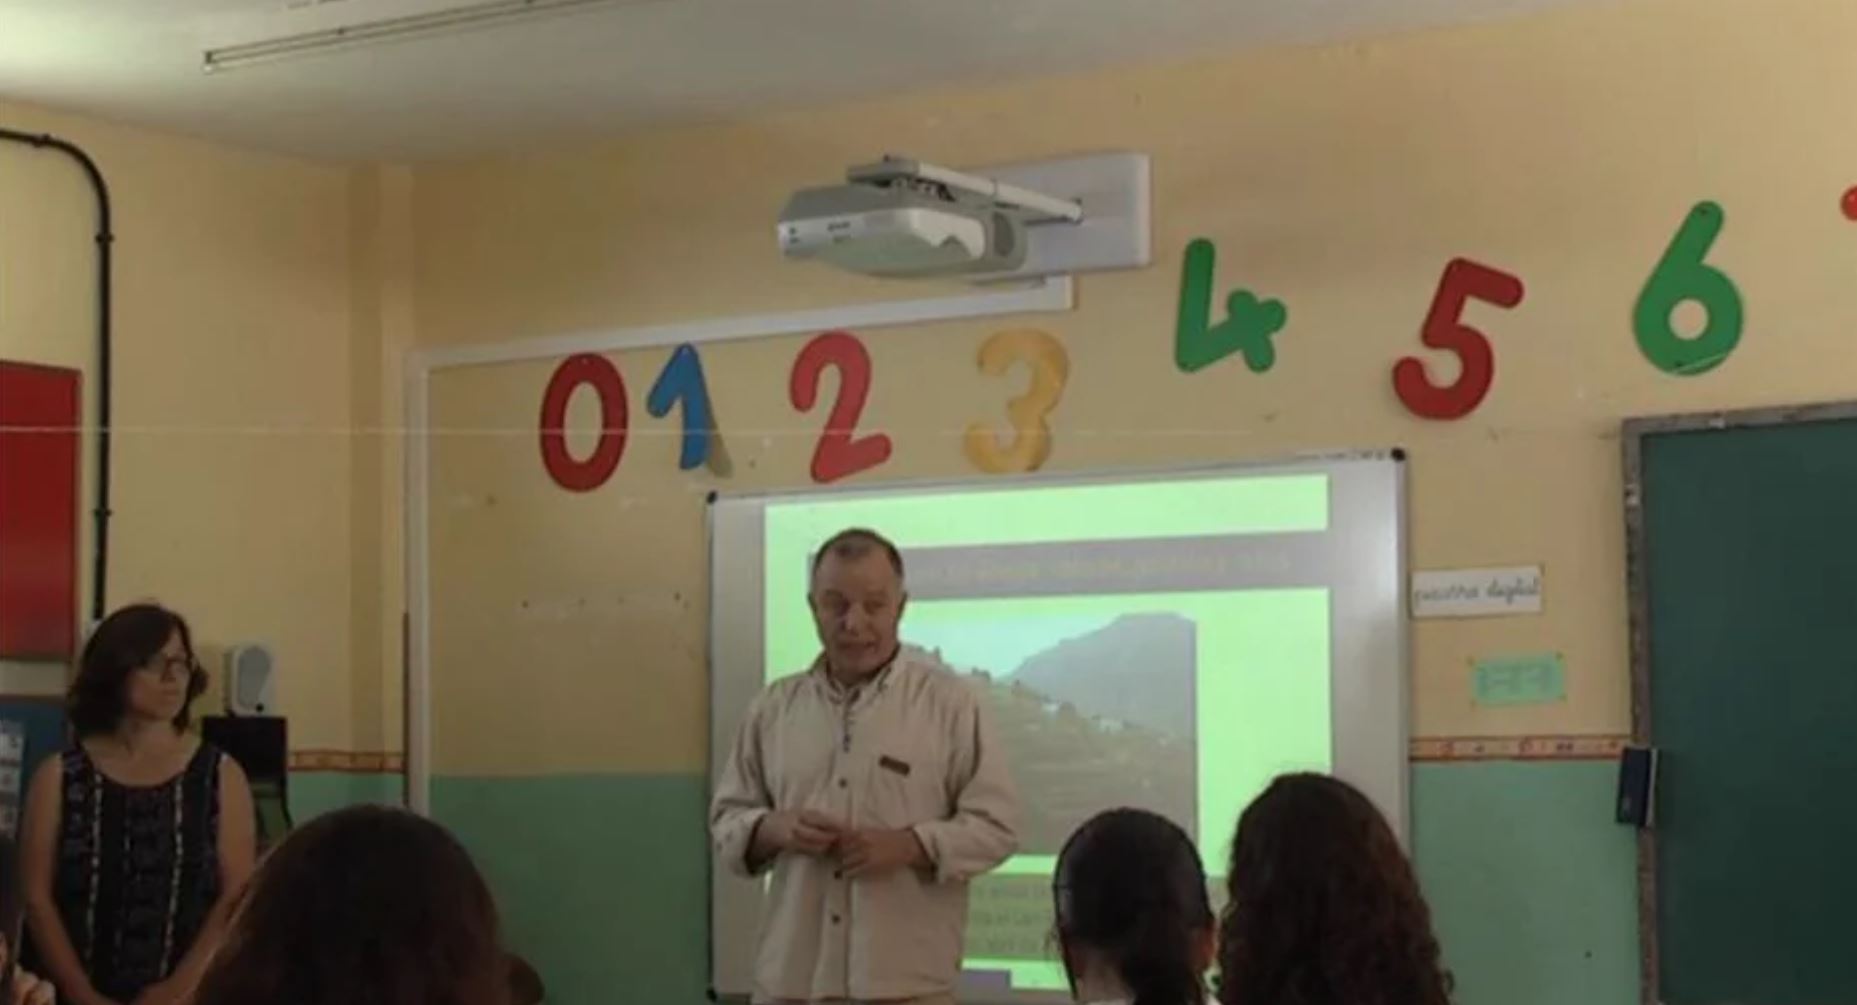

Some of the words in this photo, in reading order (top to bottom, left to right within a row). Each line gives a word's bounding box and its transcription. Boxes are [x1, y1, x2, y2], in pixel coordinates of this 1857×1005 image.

[538, 352, 628, 492] 0
[646, 343, 710, 470] 1
[788, 330, 893, 484] 2
[963, 327, 1070, 474] 3
[1174, 237, 1287, 373] 4
[1391, 256, 1525, 421] 5
[1632, 200, 1744, 376] 6
